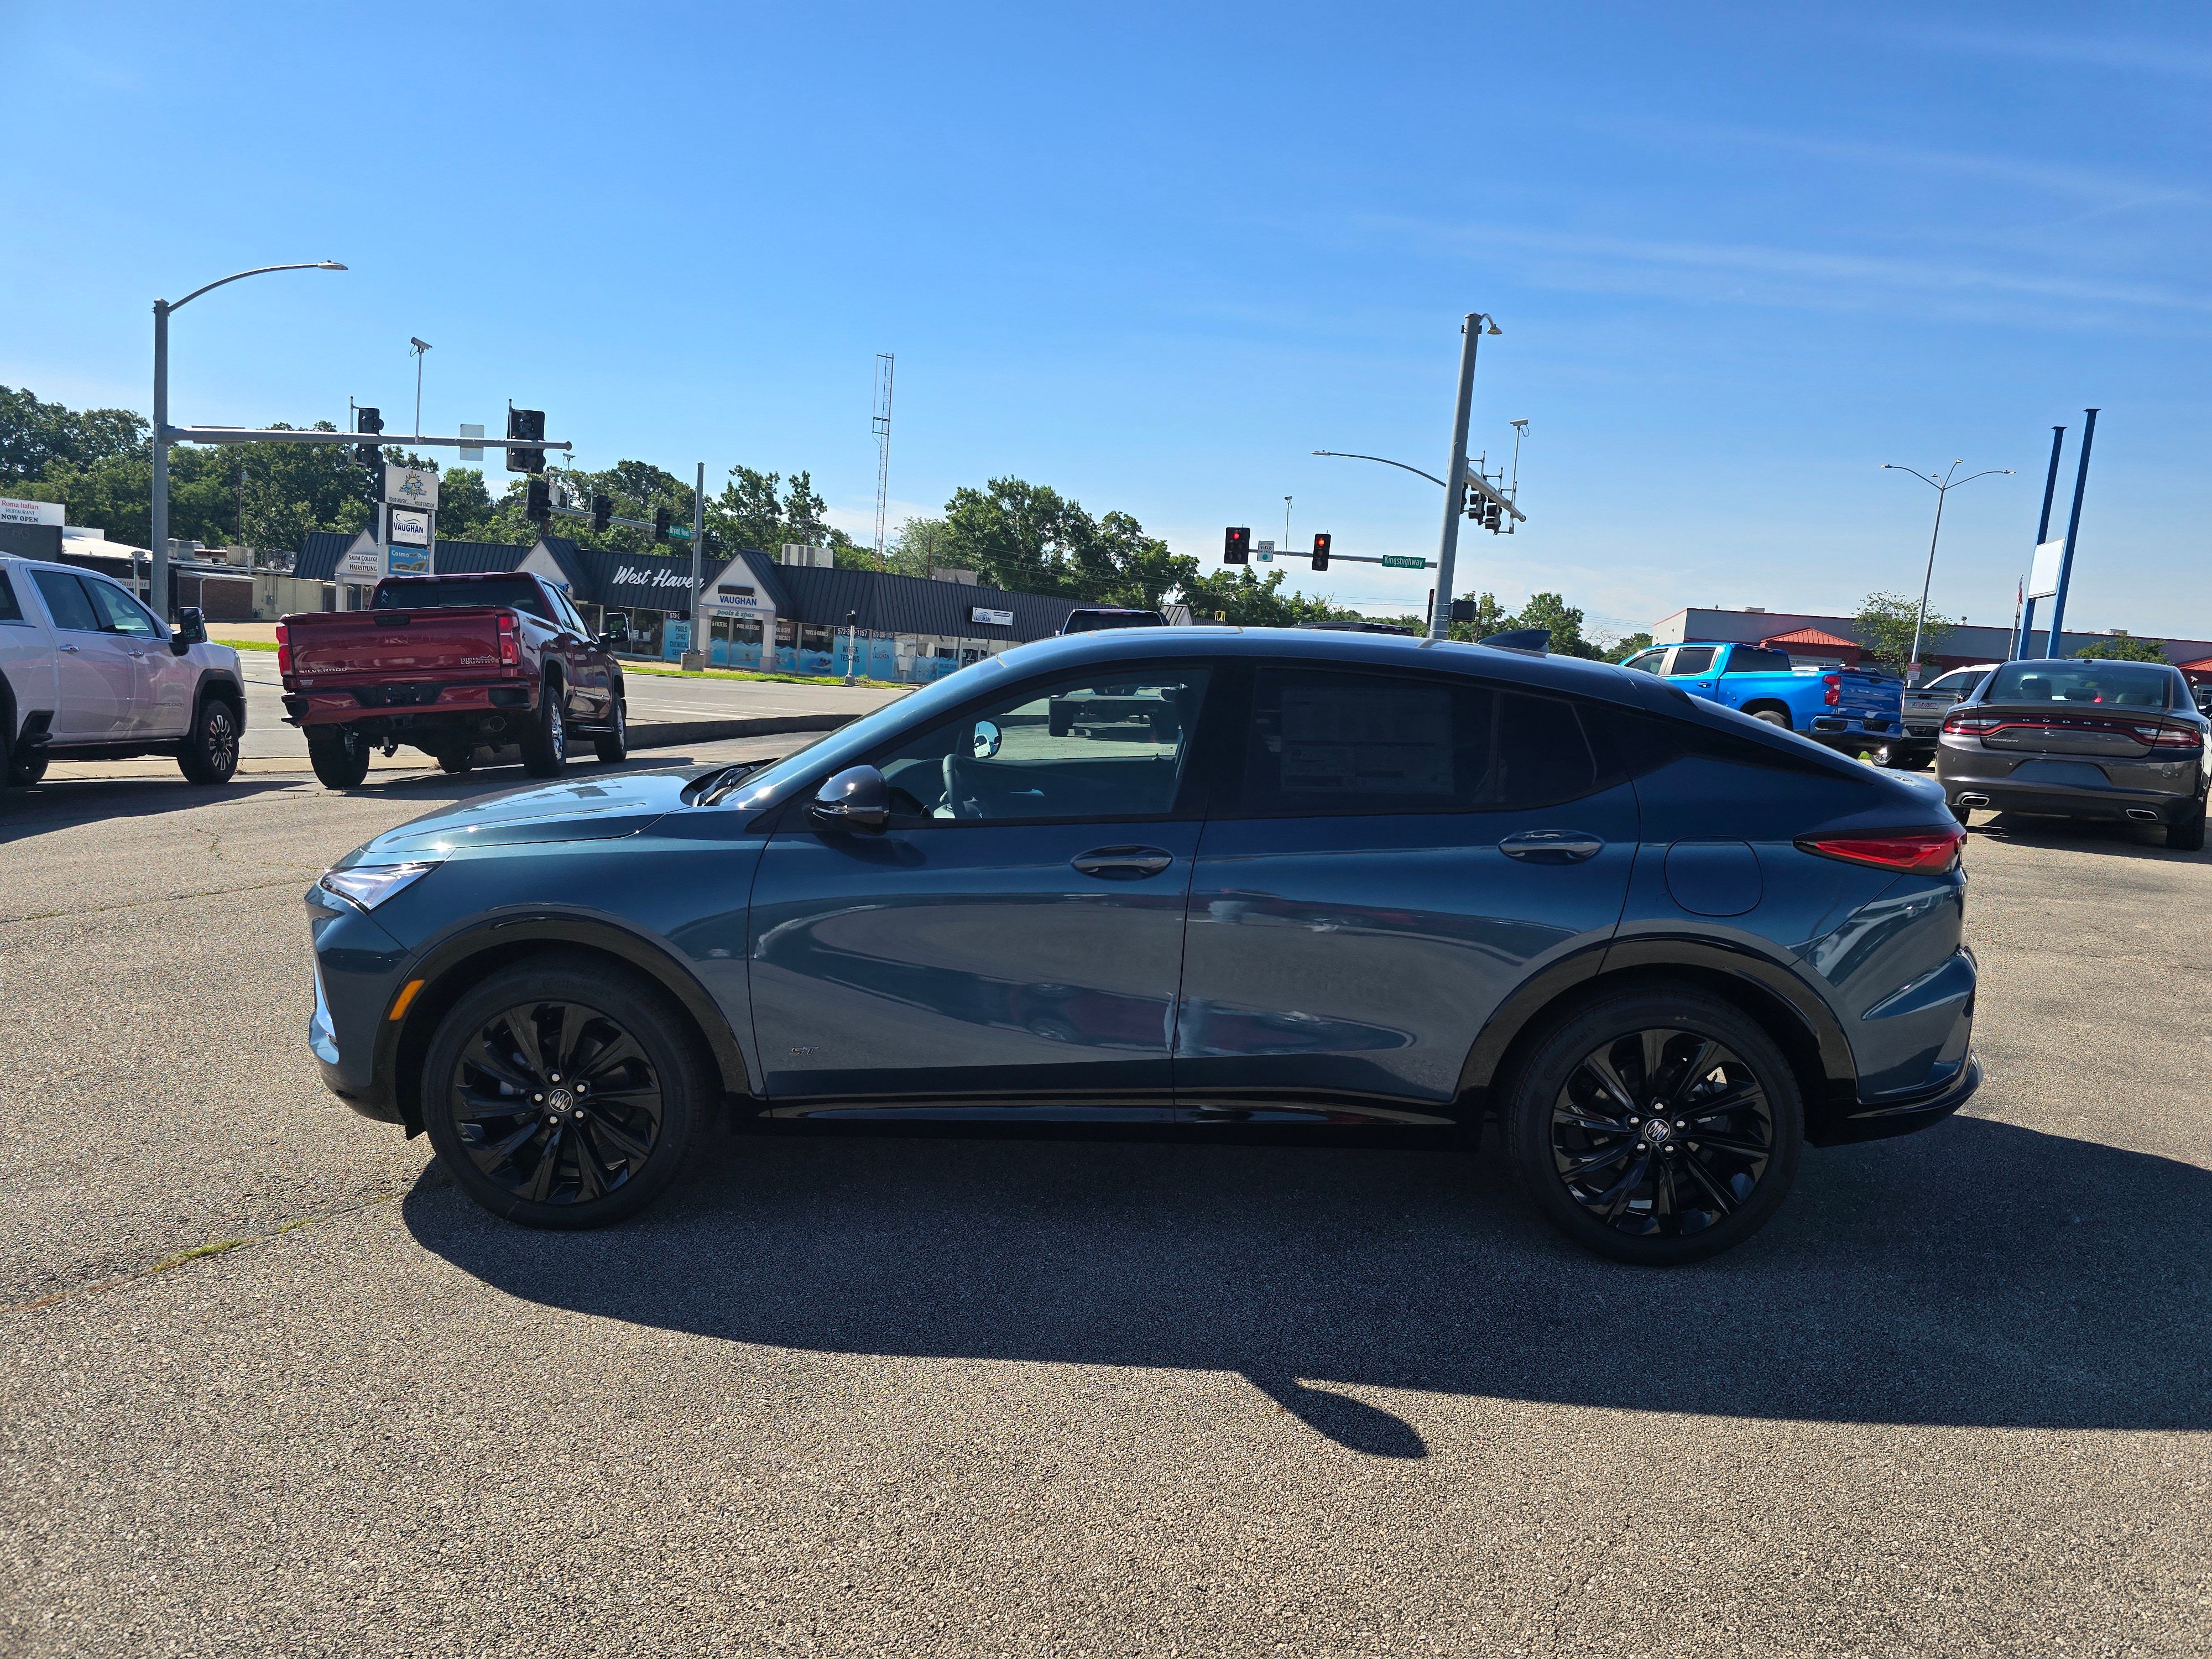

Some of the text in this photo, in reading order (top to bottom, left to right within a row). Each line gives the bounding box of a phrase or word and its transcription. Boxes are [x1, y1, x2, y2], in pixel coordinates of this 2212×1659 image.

[394, 522, 423, 533] VAUGHAN
[1384, 556, 1423, 568] Kingshighway
[612, 566, 652, 585] West
[719, 596, 757, 606] VAUGHAN
[837, 628, 868, 637] 573-3-1157
[840, 654, 860, 663] TESNG
[2022, 718, 2111, 727] DODGE
